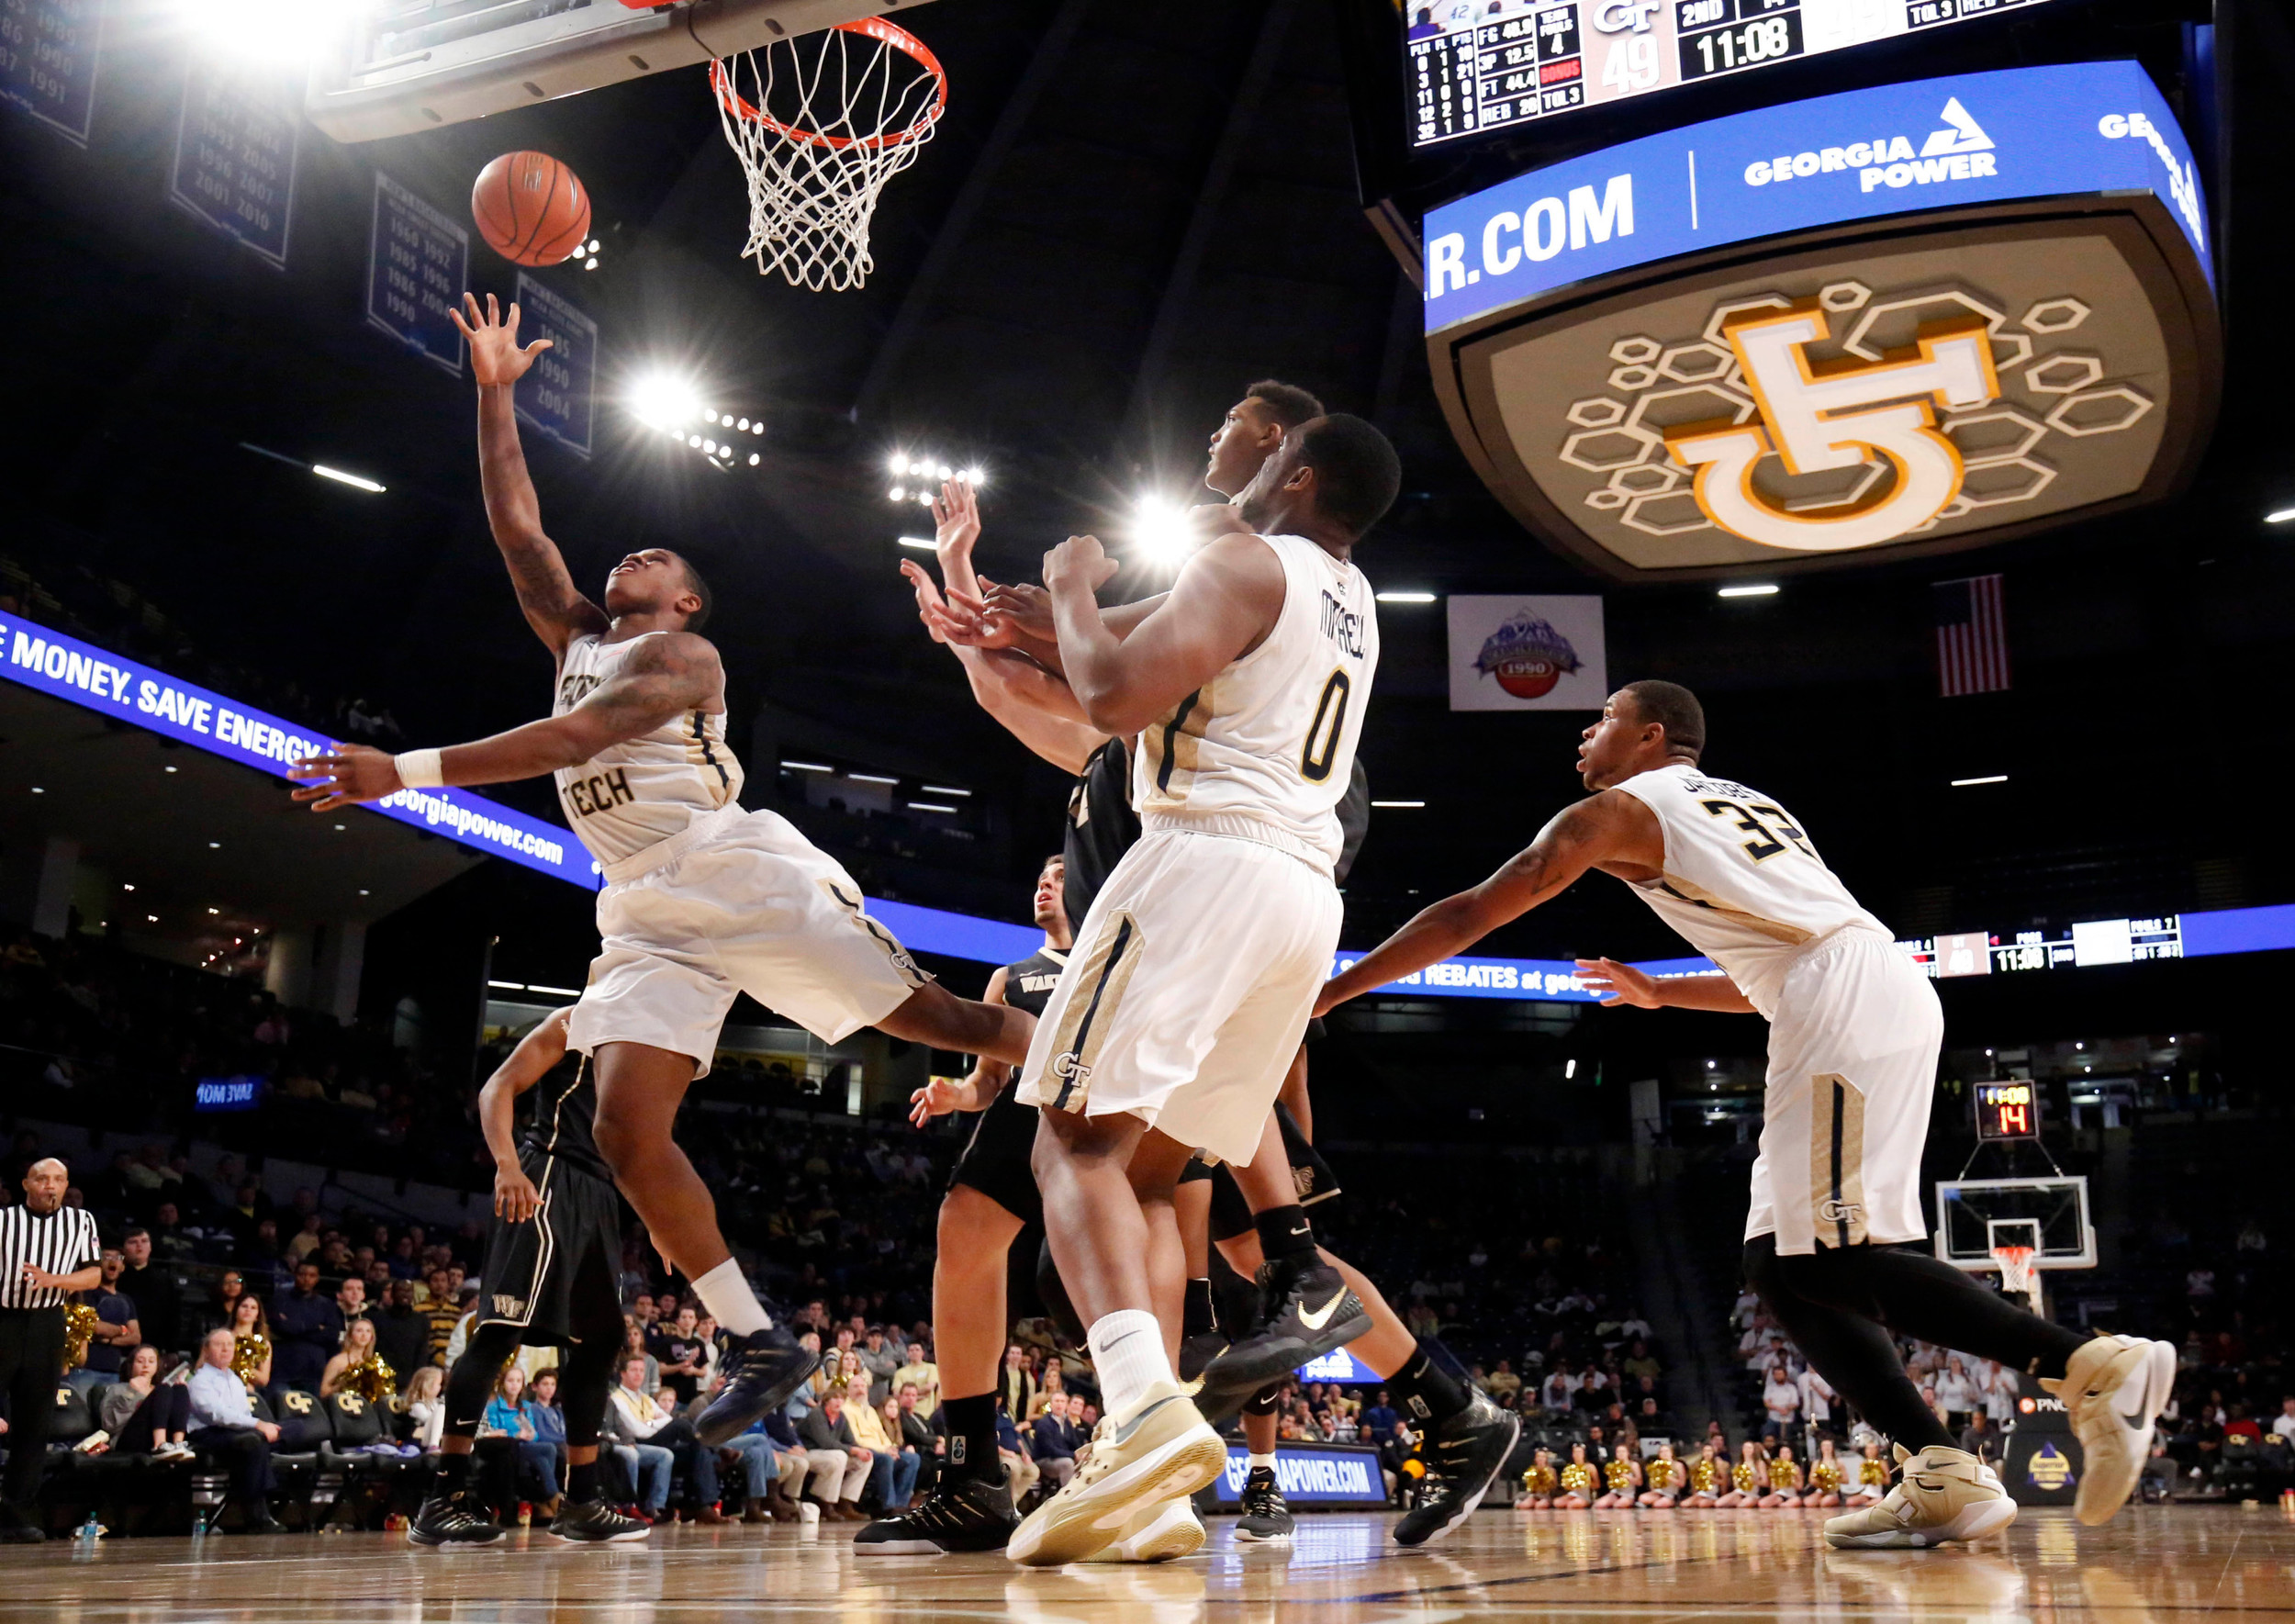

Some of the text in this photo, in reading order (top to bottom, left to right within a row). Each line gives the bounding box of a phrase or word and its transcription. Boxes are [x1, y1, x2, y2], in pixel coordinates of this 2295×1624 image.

[1593, 0, 1660, 34] GT
[1681, 2, 1724, 28] 2ND
[1941, 1, 1954, 17] 3
[1478, 26, 1499, 47] FG
[1551, 33, 1564, 55] 4
[1696, 17, 1790, 73] 11:08
[1439, 50, 1449, 67] 1
[1479, 44, 1534, 73] 3P 12.5
[1602, 33, 1661, 95] 49
[1418, 62, 1473, 89] 3 1 21
[1481, 70, 1536, 98] FT 44.4
[1539, 60, 1581, 84] BONUS
[1416, 88, 1433, 106] 11
[1569, 86, 1581, 104] 3
[1417, 105, 1436, 123] 12
[1441, 101, 1452, 118] 2
[1482, 103, 1512, 125] REB
[1444, 118, 1452, 134] 1
[1743, 135, 1917, 187] GEORGIA
[1859, 151, 1998, 193] POWER
[1427, 173, 1634, 300] R.COM
[1506, 663, 1546, 675] 1990
[10, 630, 130, 705] MONEY.
[137, 679, 213, 734] SAVE
[215, 708, 321, 771] ENERGY
[1300, 665, 1351, 786] 0
[378, 787, 564, 866] georgiapower.com
[1997, 946, 2044, 972] 11:08
[1425, 963, 1517, 990] REBATES
[1521, 969, 1543, 991] at
[1052, 1050, 1092, 1089] GT
[1987, 1086, 2030, 1105] 11:08
[1999, 1104, 2028, 1134] 14
[1819, 1197, 1863, 1225] GT
[285, 1392, 313, 1415] GT
[337, 1394, 364, 1416] GT
[2035, 1397, 2070, 1413] PNC
